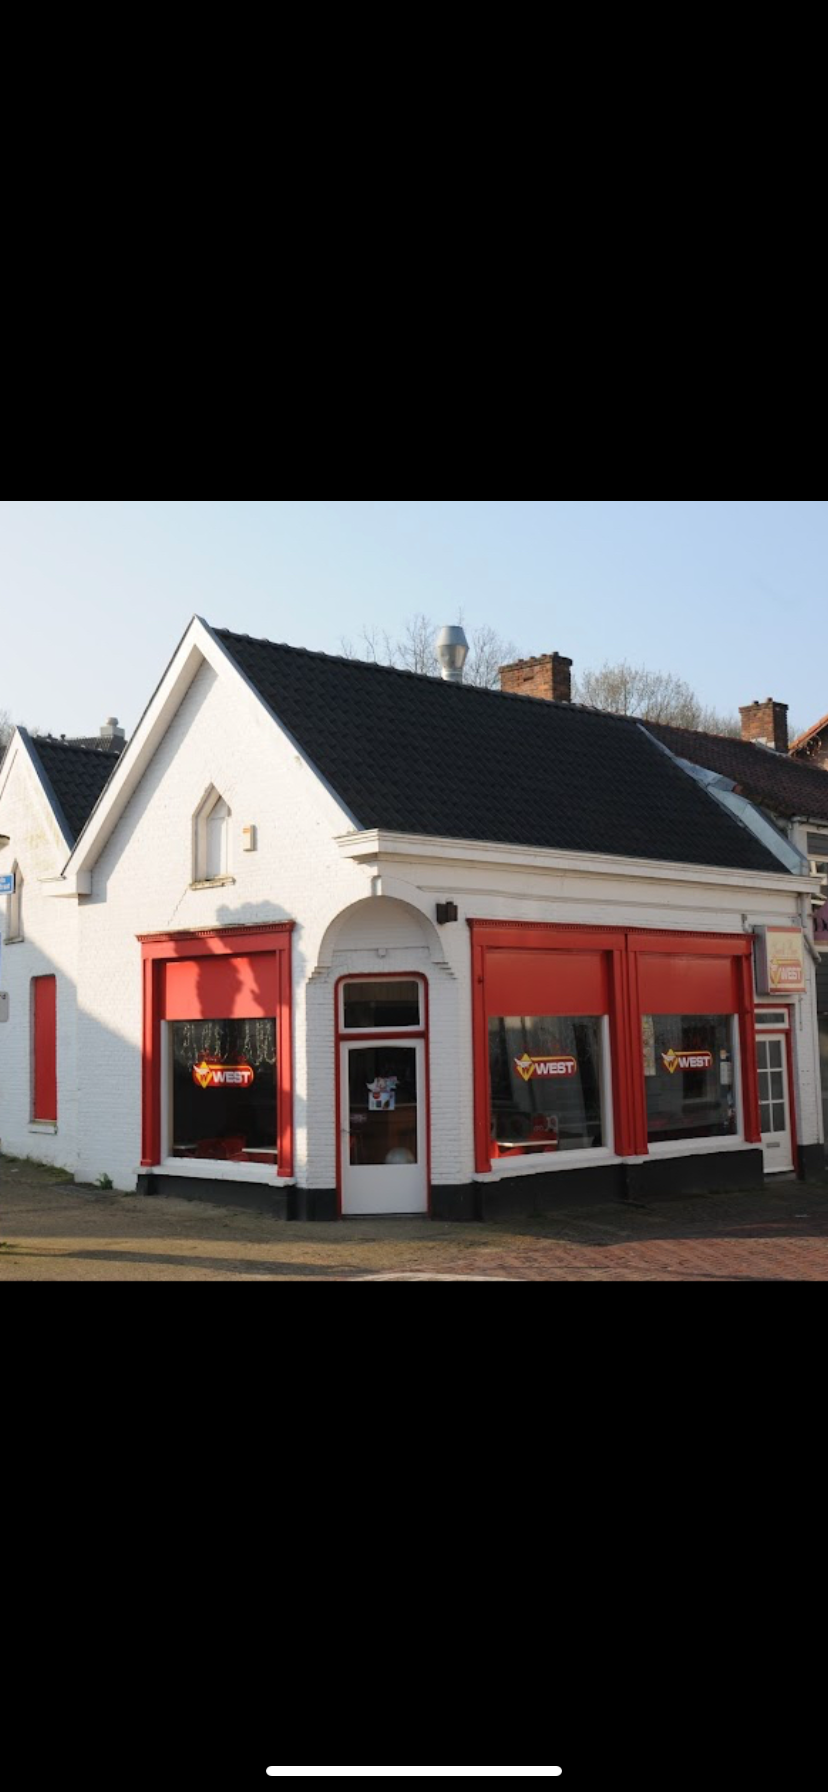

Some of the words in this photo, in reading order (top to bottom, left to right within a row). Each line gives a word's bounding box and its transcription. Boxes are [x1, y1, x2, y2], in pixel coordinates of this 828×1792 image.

[780, 967, 802, 980] WEST
[534, 1062, 573, 1075] WEST
[678, 1056, 711, 1068] WEST
[212, 1071, 250, 1084] WEST
